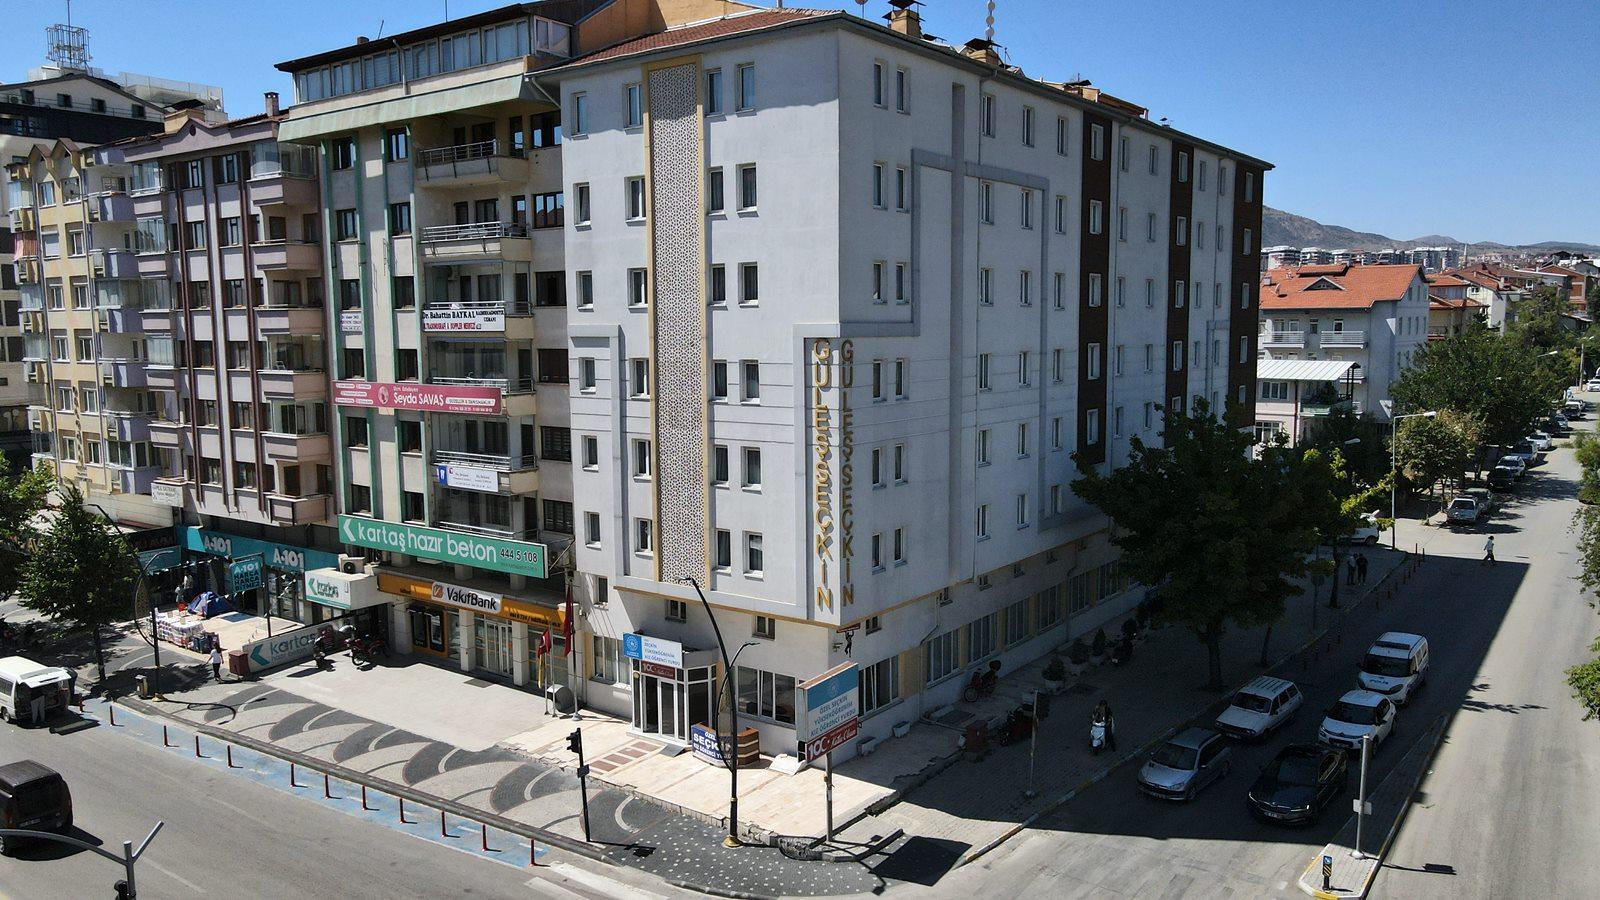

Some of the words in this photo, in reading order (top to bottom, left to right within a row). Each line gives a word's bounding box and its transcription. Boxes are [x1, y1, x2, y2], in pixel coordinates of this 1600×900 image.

[358, 523, 405, 552] kartaş
[407, 529, 443, 553] hazır
[448, 535, 496, 563] beton
[500, 548, 514, 559] 444
[516, 550, 522, 561] 5
[523, 551, 538, 564] 108
[447, 587, 497, 611] VakıfBank
